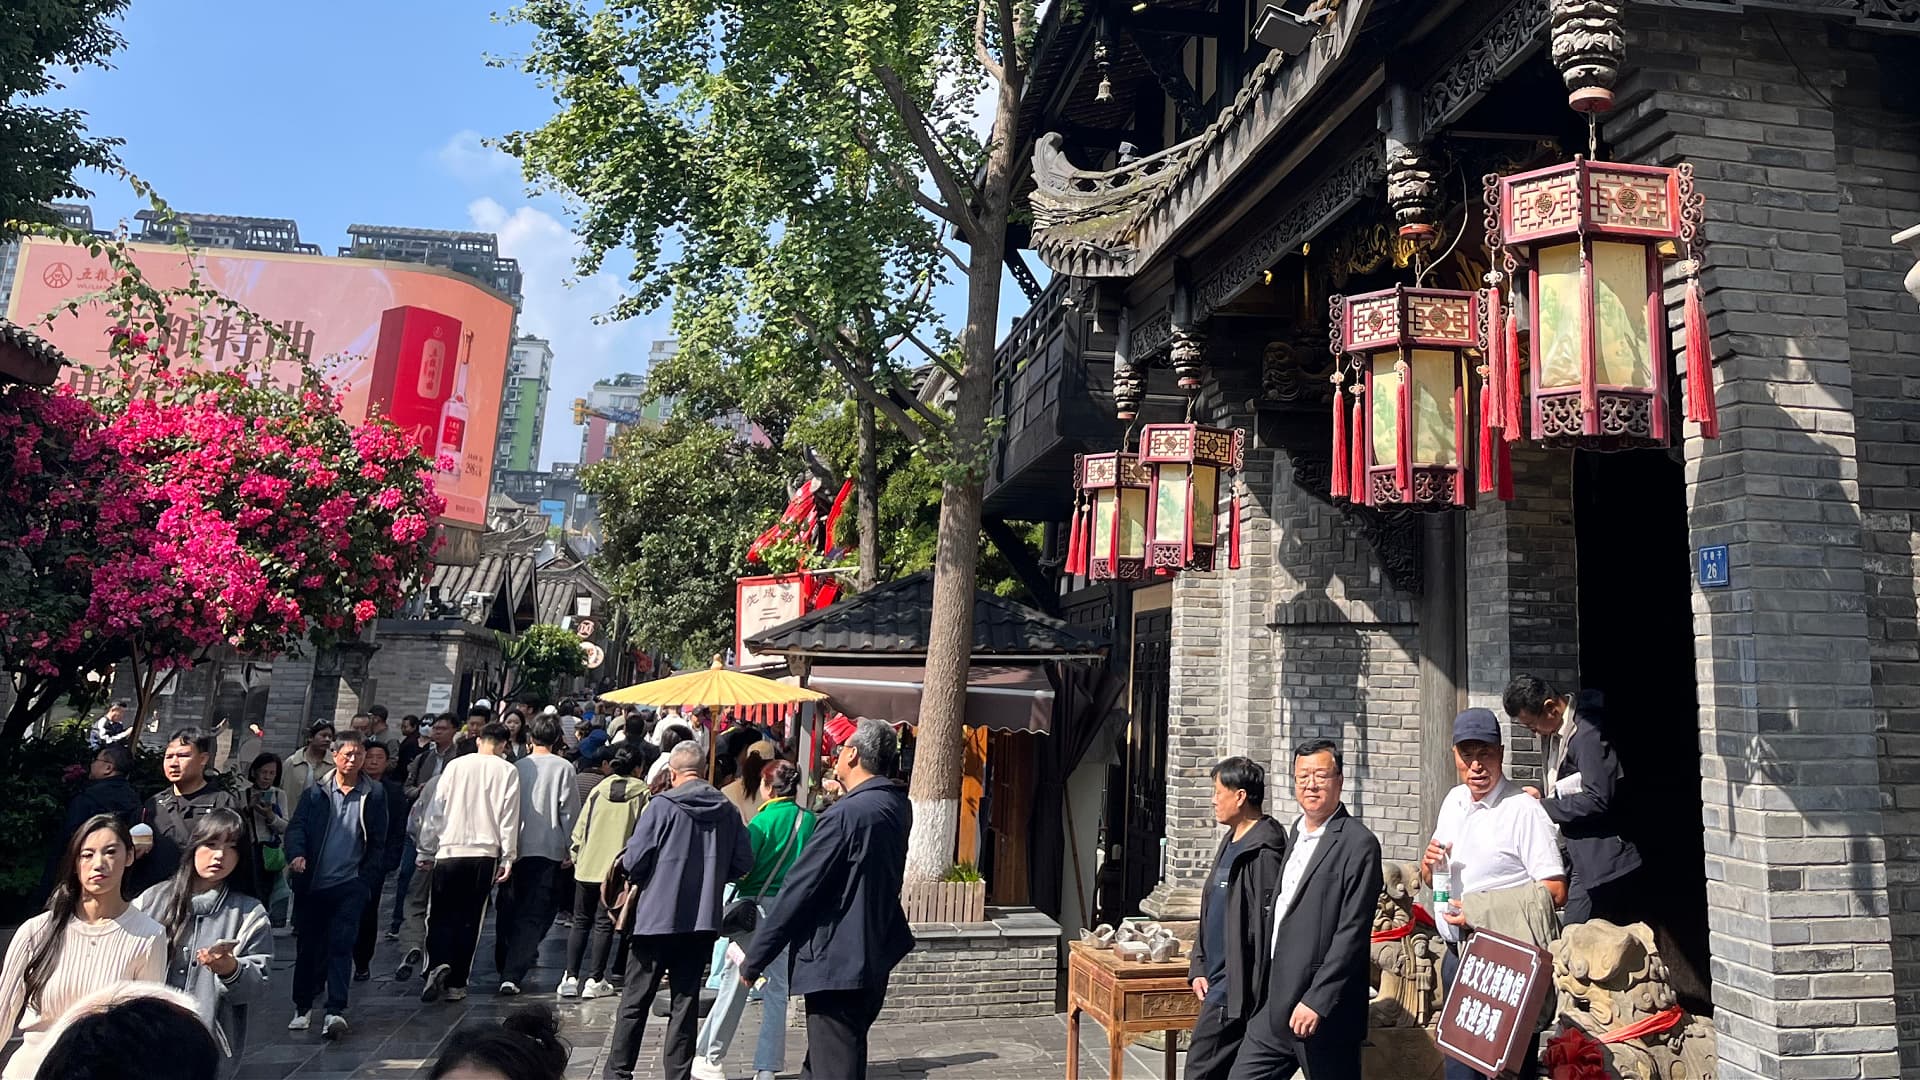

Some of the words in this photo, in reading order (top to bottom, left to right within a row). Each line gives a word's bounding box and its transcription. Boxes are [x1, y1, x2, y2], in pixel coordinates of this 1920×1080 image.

[96, 312, 316, 363] 粮特曲
[1707, 562, 1718, 579] 26
[1455, 996, 1503, 1042] 欢迎参观
